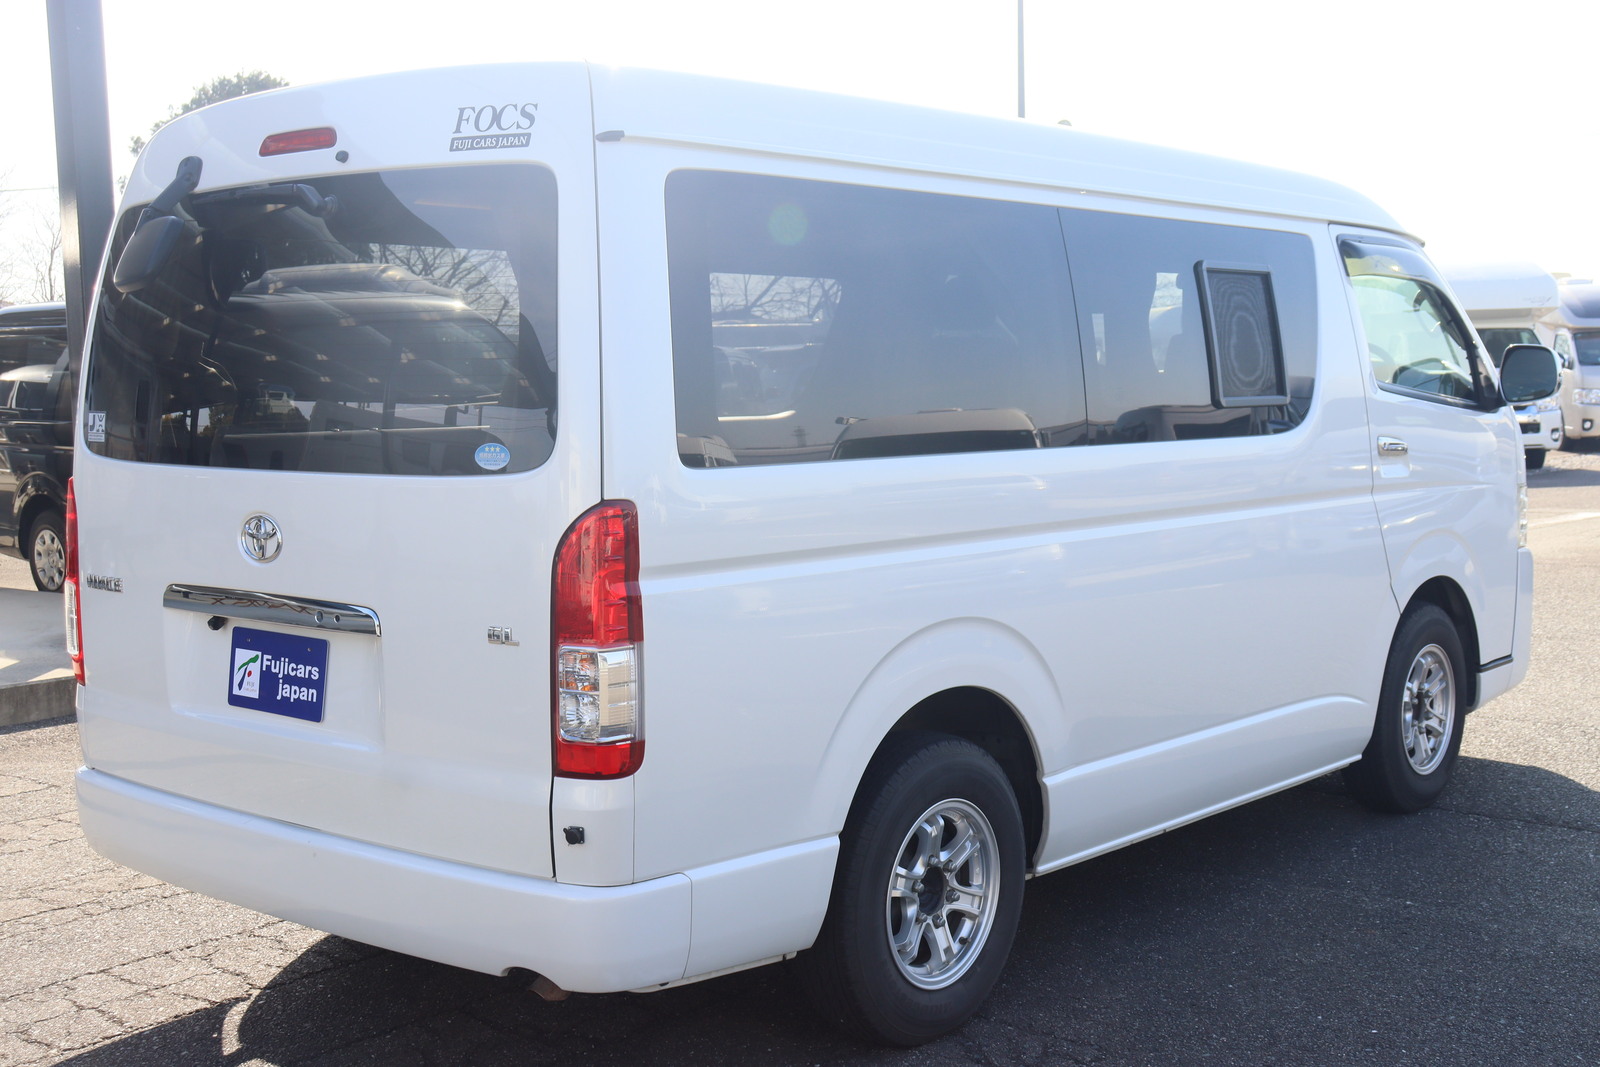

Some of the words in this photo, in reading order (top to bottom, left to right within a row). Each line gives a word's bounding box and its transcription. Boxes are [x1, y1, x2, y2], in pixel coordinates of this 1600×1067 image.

[452, 103, 538, 134] FOCS
[453, 140, 472, 150] FUJI
[473, 137, 497, 148] CARS
[497, 136, 527, 148] JAPAN
[487, 625, 520, 647] GL
[262, 654, 319, 680] Fujicars
[276, 679, 317, 702] japan
